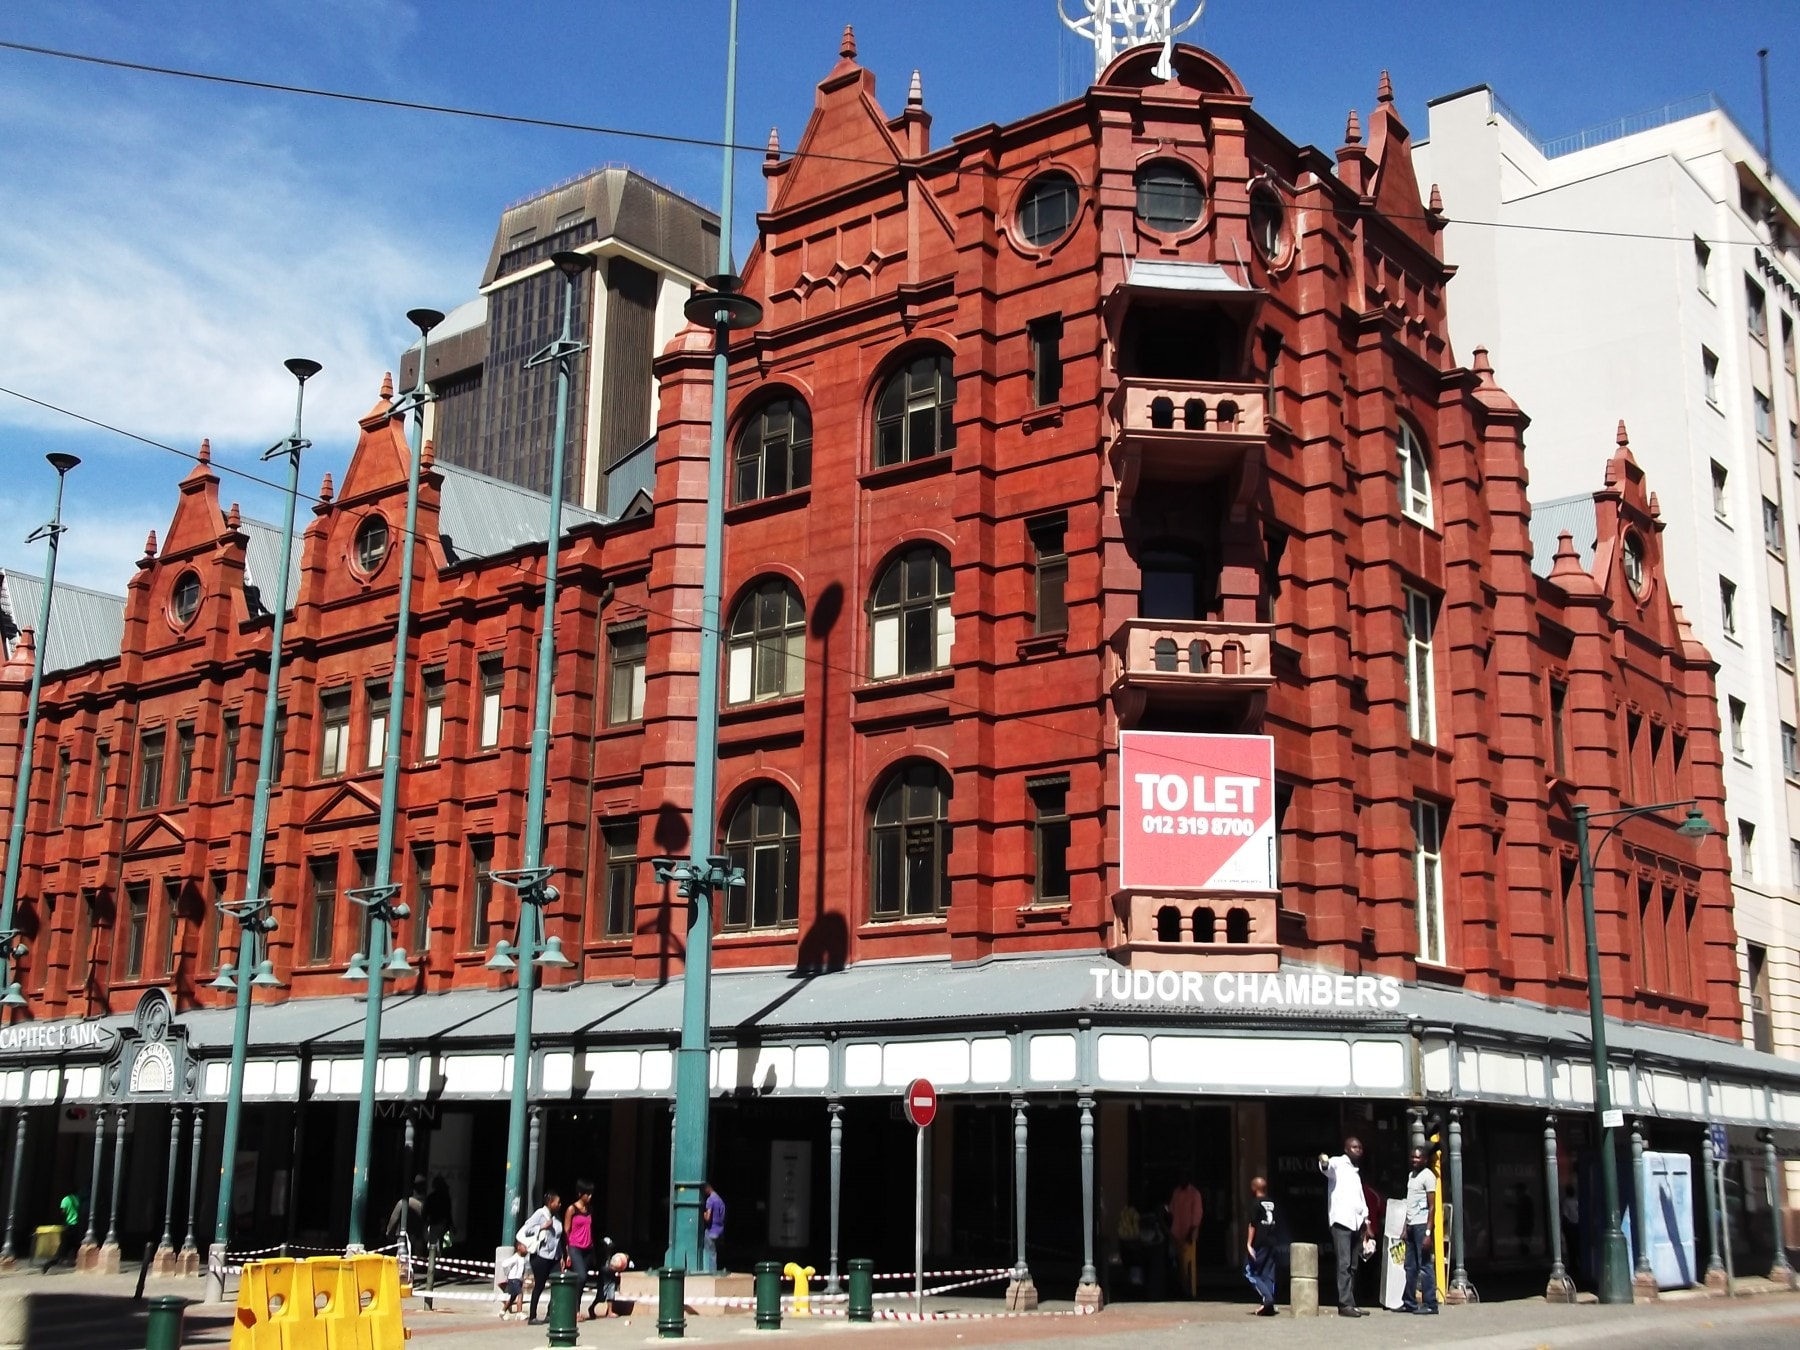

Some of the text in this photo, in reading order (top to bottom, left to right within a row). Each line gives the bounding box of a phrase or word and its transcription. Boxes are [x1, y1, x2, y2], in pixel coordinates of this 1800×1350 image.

[1134, 773, 1261, 814] TO LET
[1142, 815, 1255, 837] 012 319 8700
[1089, 967, 1401, 1008] TUDOR CHAMBERS
[0, 1023, 100, 1049] CAPITEC BANK
